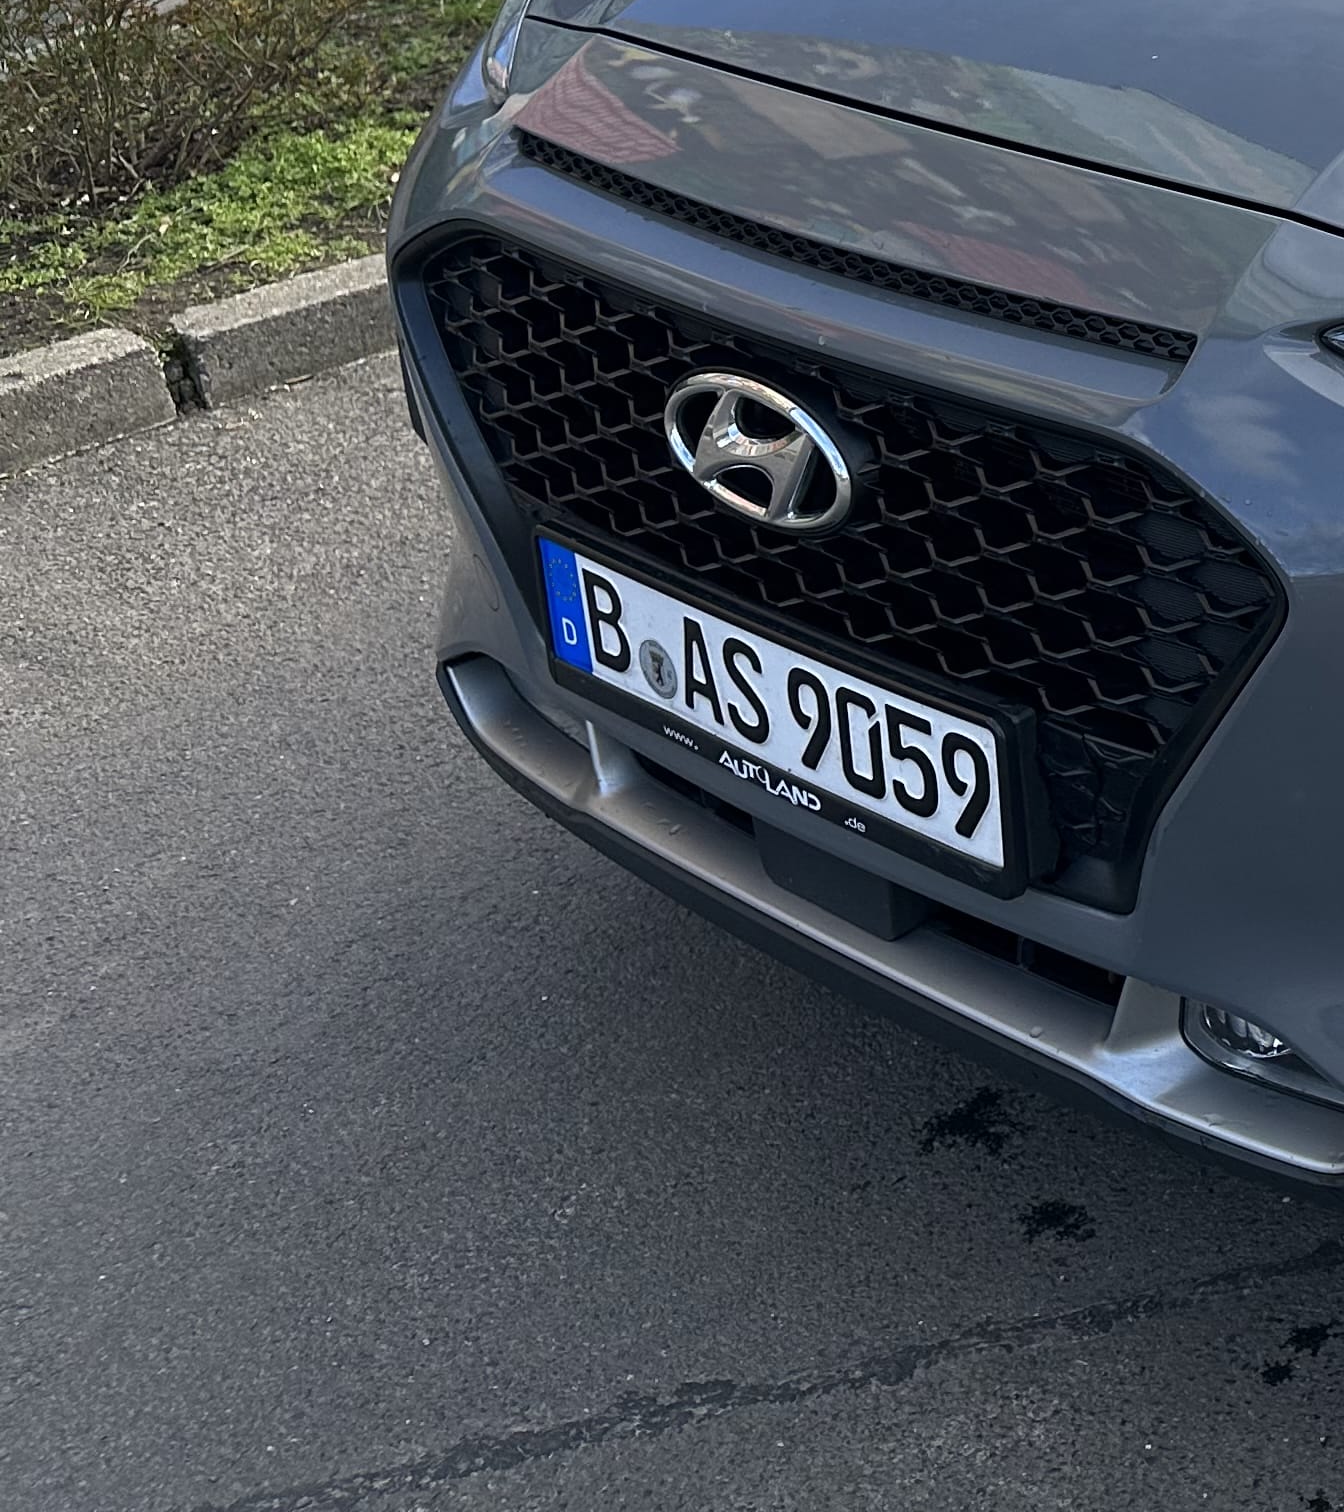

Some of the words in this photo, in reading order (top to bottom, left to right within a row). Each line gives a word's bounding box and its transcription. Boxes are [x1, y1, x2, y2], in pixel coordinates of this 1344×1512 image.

[562, 617, 578, 646] D
[582, 568, 631, 673] B
[683, 616, 770, 744] AS
[787, 667, 991, 839] 9059
[663, 725, 699, 751] www.
[719, 750, 821, 811] AUTOLAND
[844, 817, 867, 833] .de
